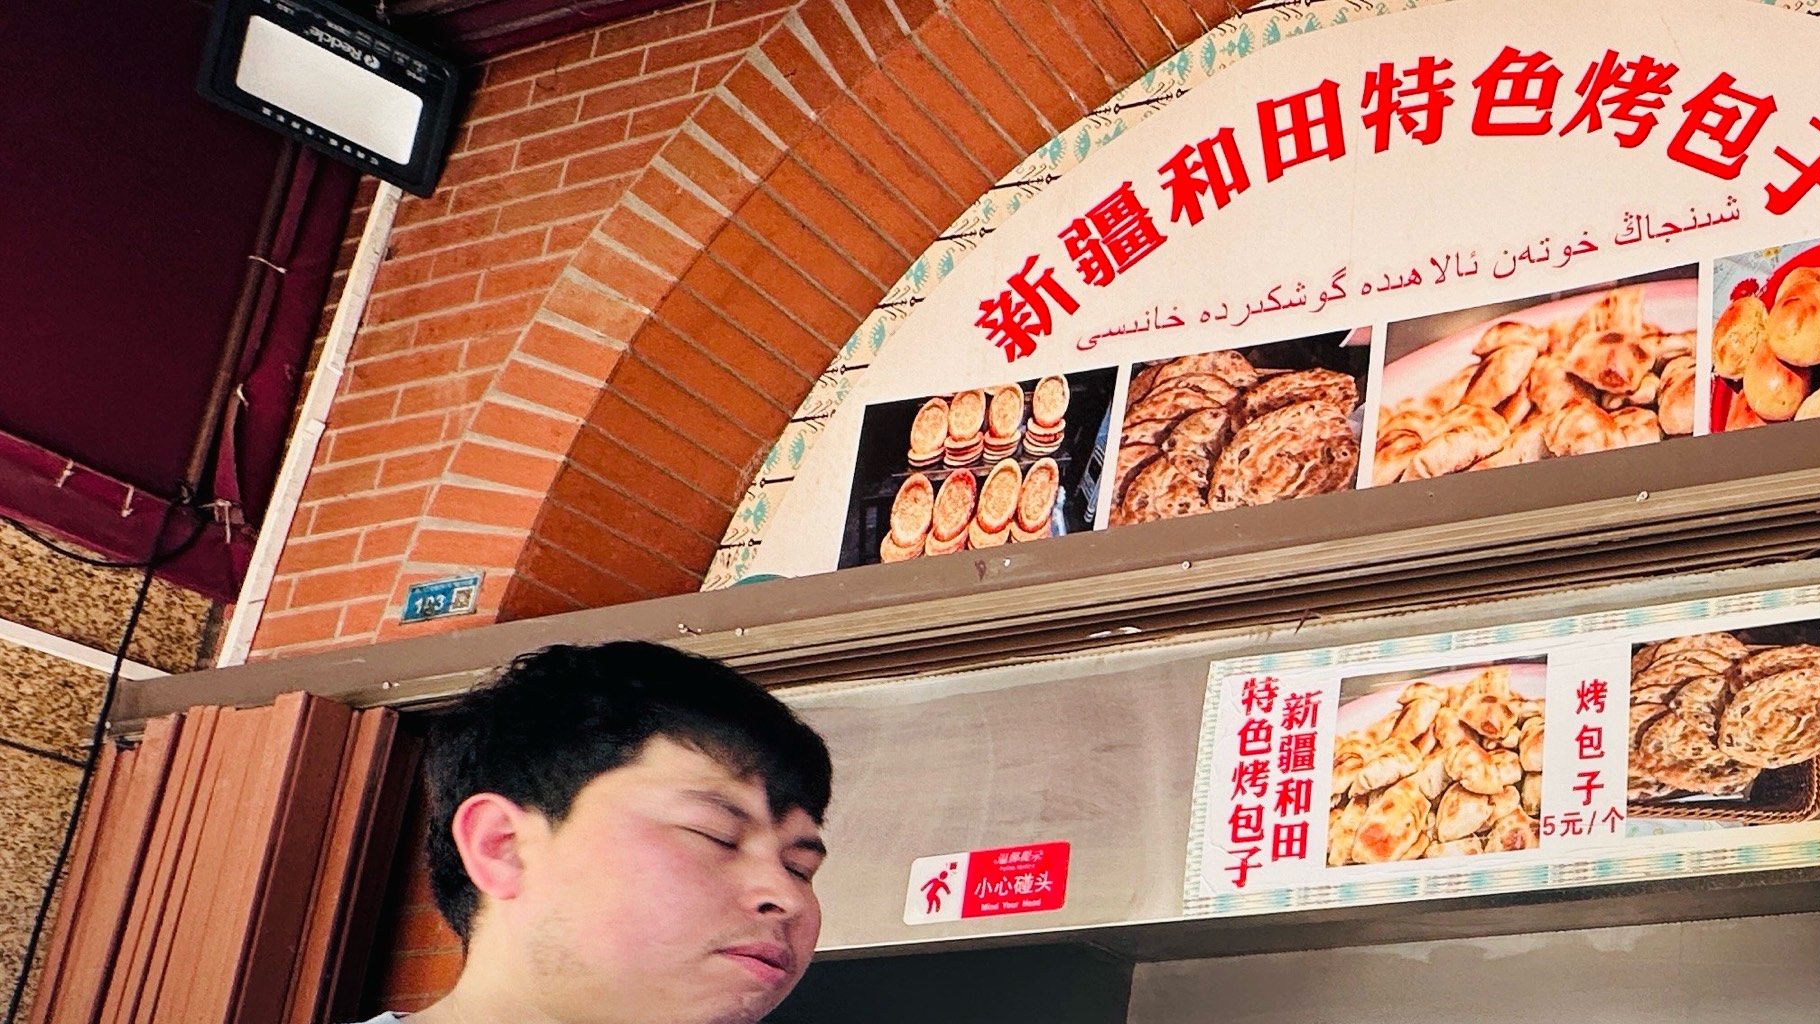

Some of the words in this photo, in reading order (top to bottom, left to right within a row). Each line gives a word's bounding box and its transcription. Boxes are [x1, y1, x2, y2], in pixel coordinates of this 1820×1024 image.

[1224, 676, 1280, 889] 特色烤包子
[1271, 690, 1323, 864] 新疆和田
[1572, 679, 1609, 807] 烤包子
[975, 871, 1053, 898] 小心碰头
[1542, 807, 1626, 838] 5元/个
